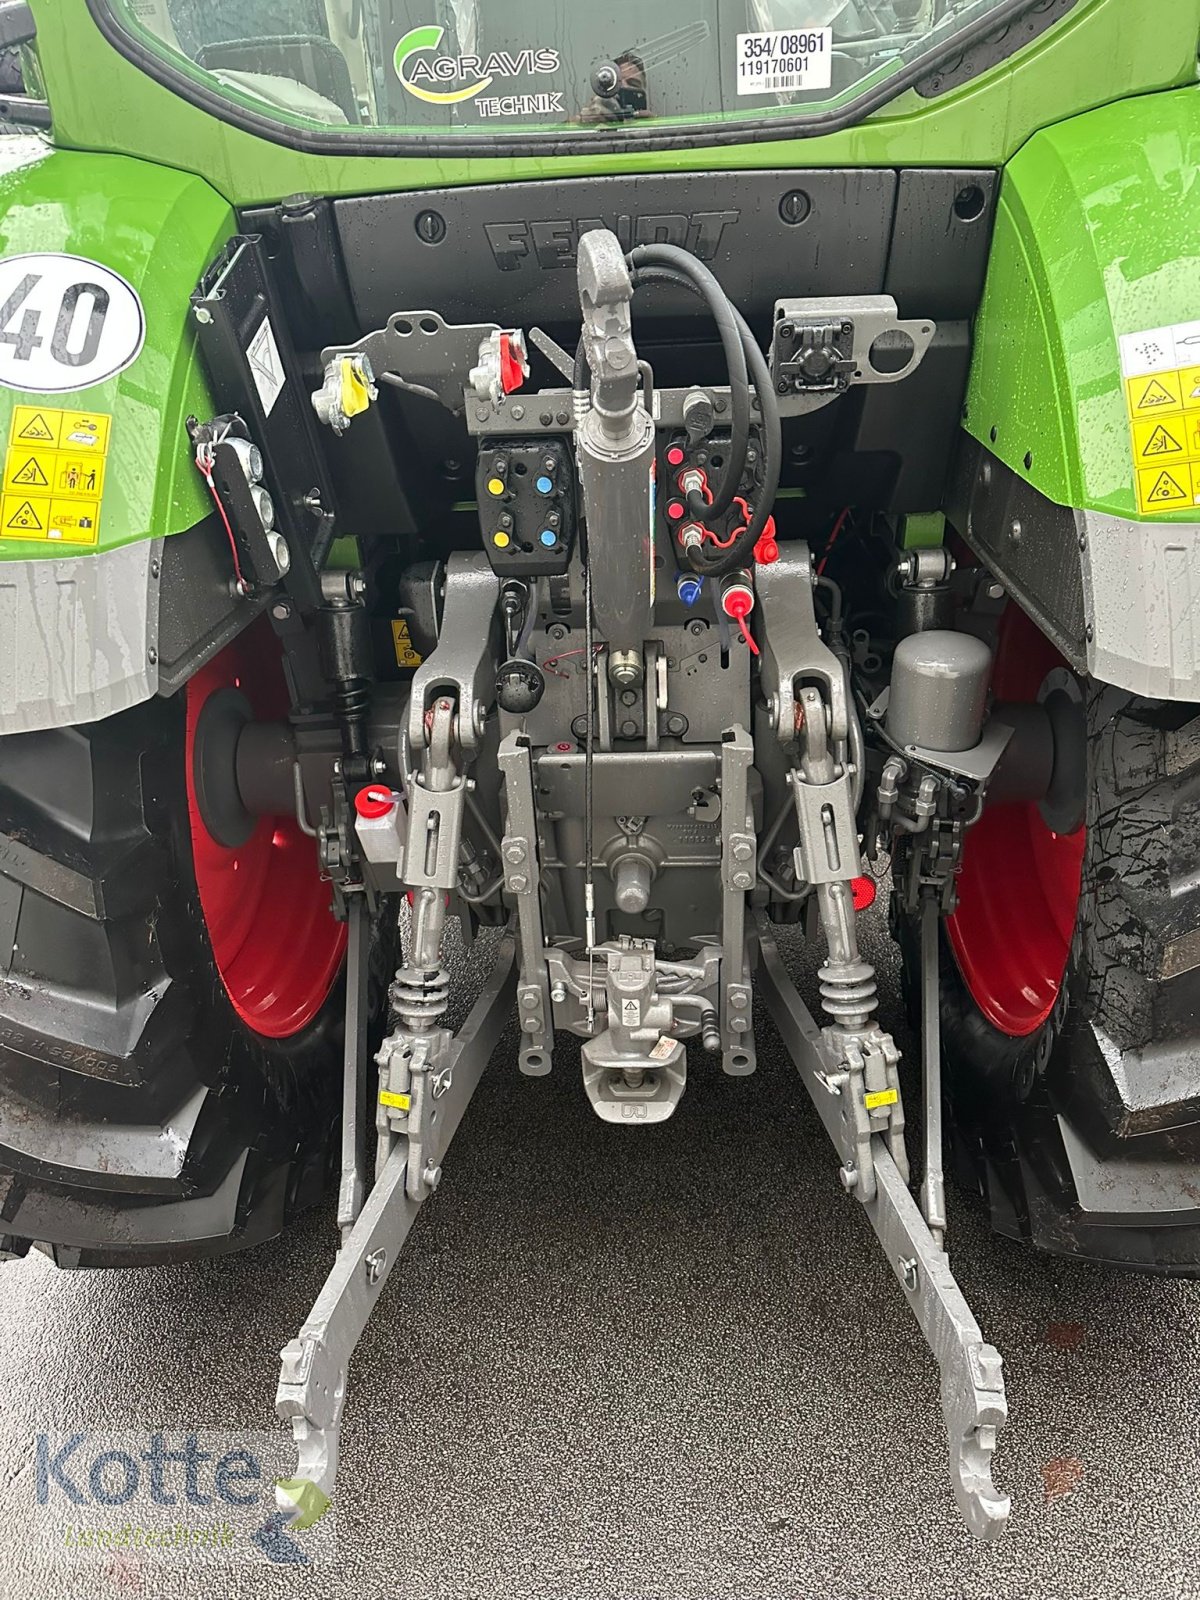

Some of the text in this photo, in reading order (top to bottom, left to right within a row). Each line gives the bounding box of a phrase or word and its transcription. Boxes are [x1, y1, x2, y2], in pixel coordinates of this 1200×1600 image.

[409, 47, 561, 84] AGRAVIS
[740, 56, 808, 77] 119170601
[475, 91, 565, 118] TECHNIK
[0, 273, 110, 367] 40
